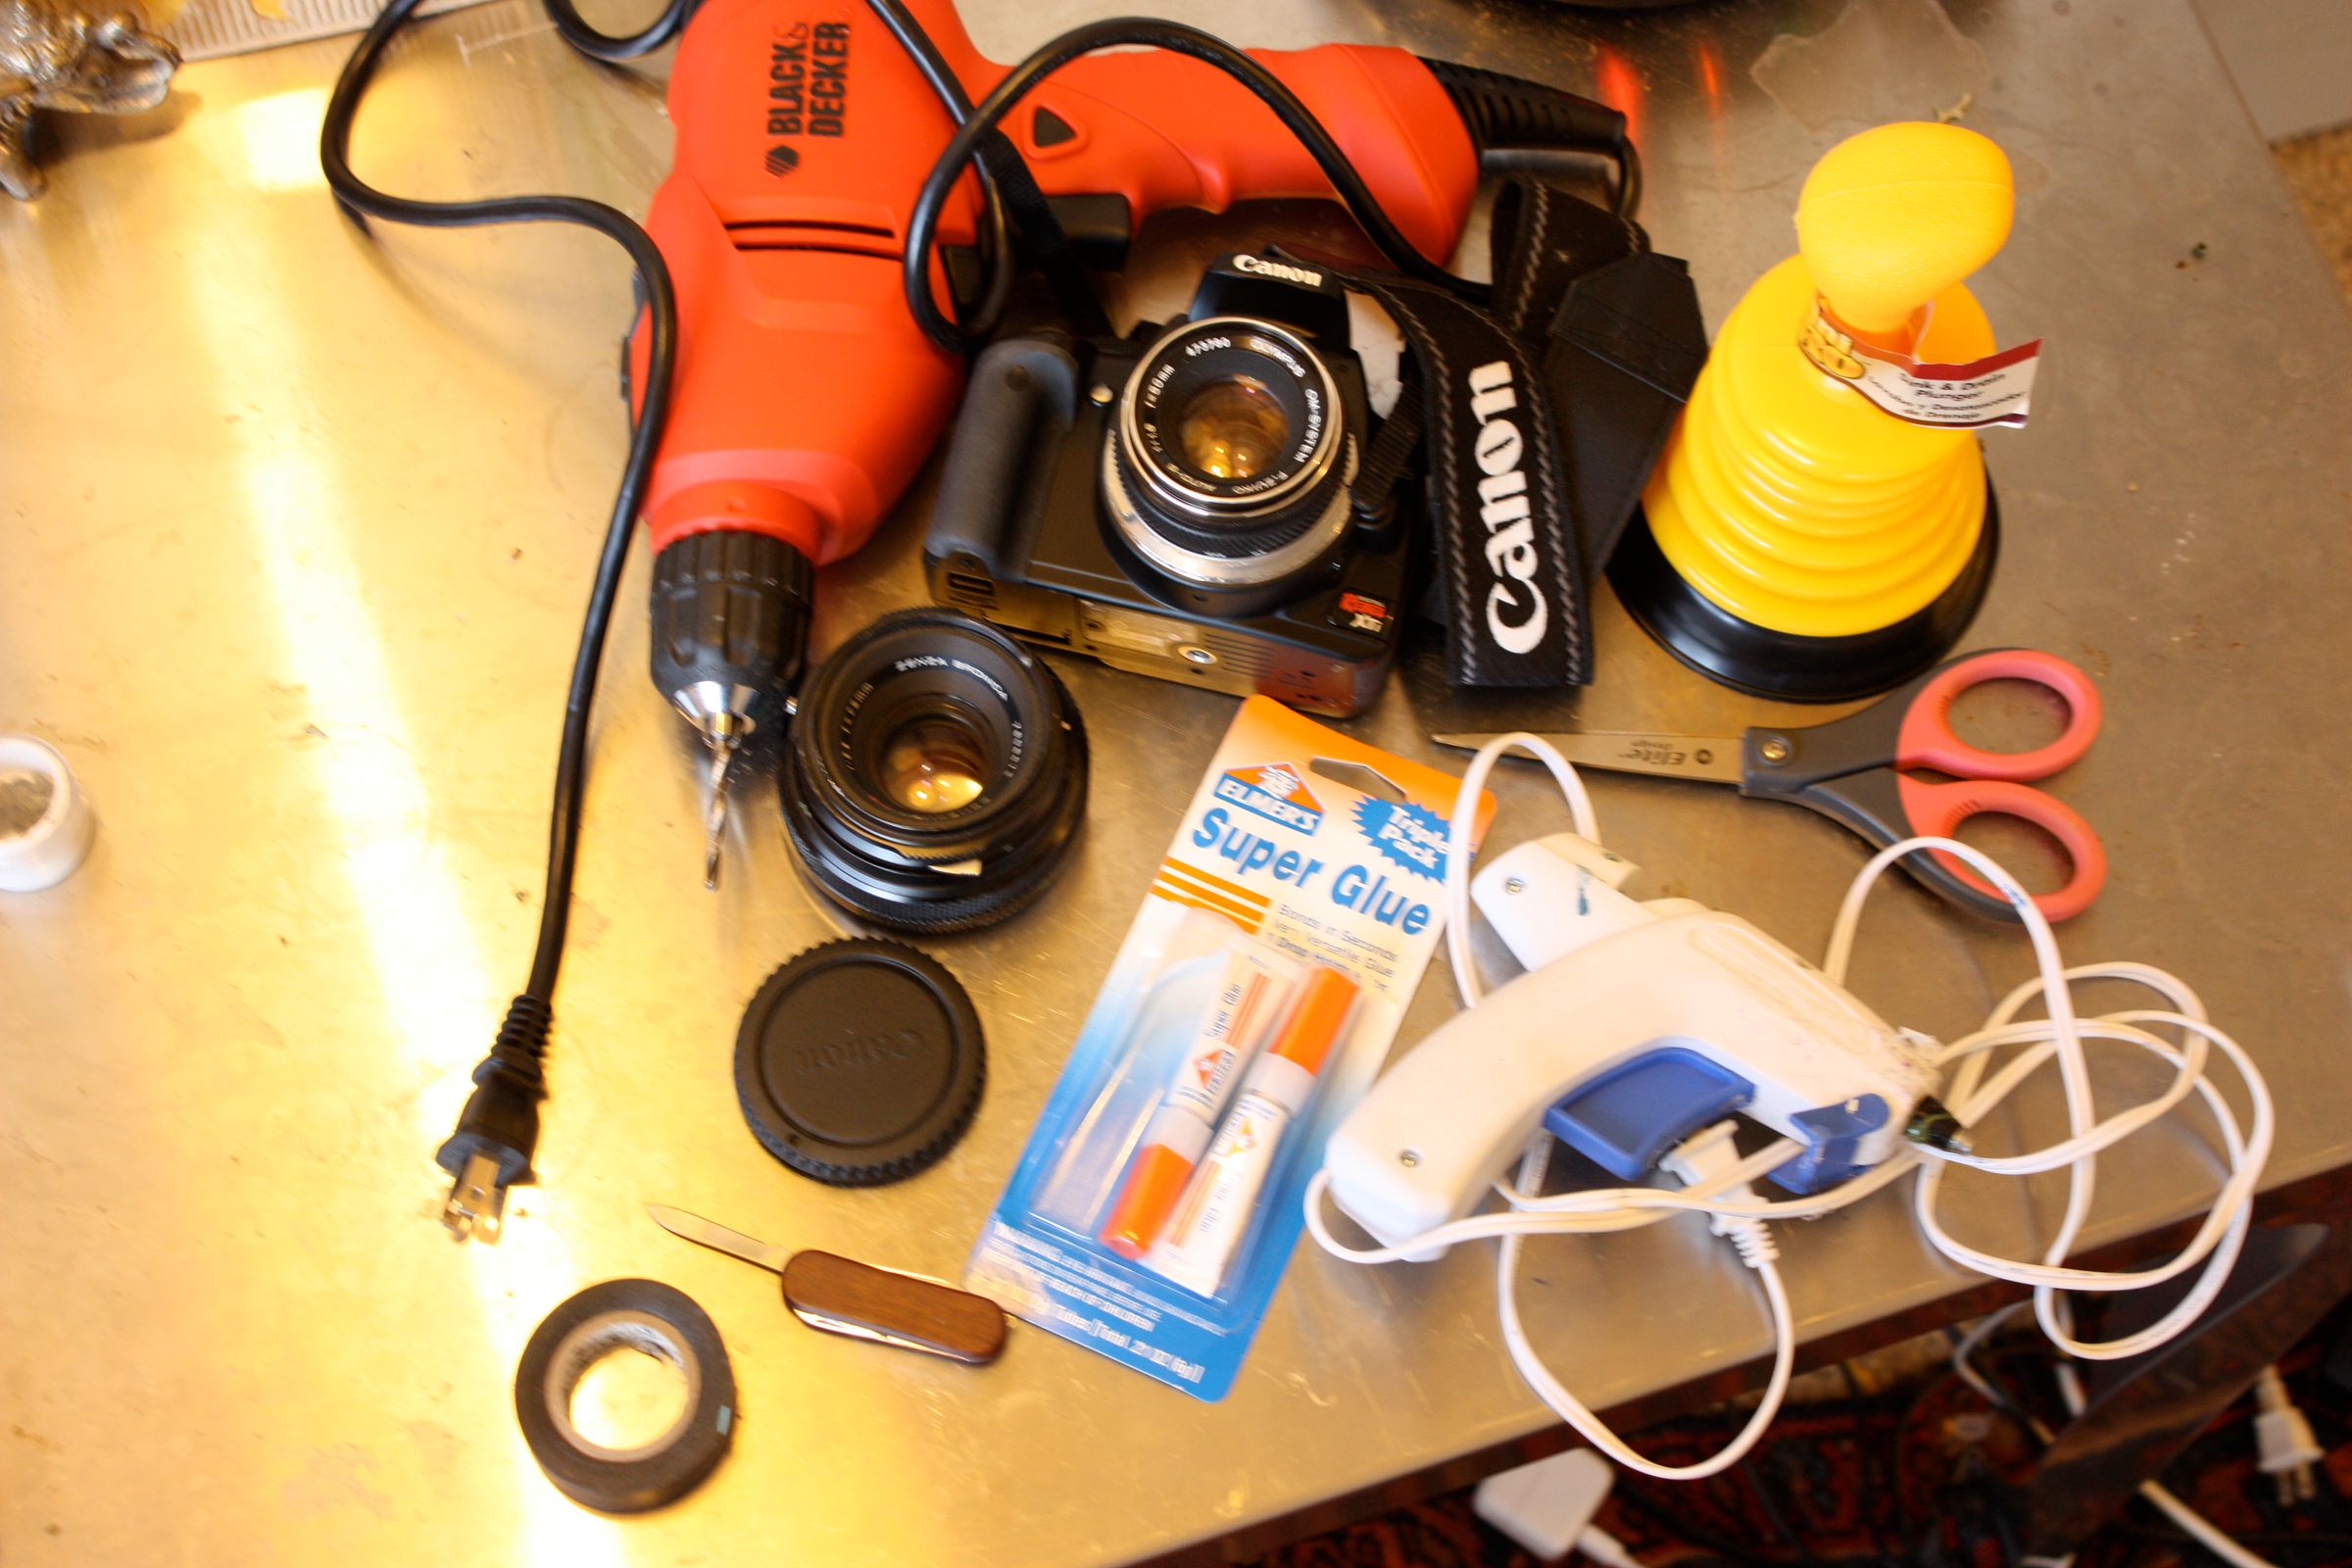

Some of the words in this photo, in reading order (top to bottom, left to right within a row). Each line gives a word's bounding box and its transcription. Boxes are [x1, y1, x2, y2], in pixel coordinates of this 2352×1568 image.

[767, 43, 808, 135] BLACK
[808, 22, 851, 137] DECKER
[1233, 255, 1322, 287] Canon
[1914, 388, 1984, 402] Plunger
[1468, 360, 1547, 655] Canon
[1192, 808, 1323, 889] Super
[1330, 864, 1432, 936] Glue
[1377, 822, 1441, 869] Pack
